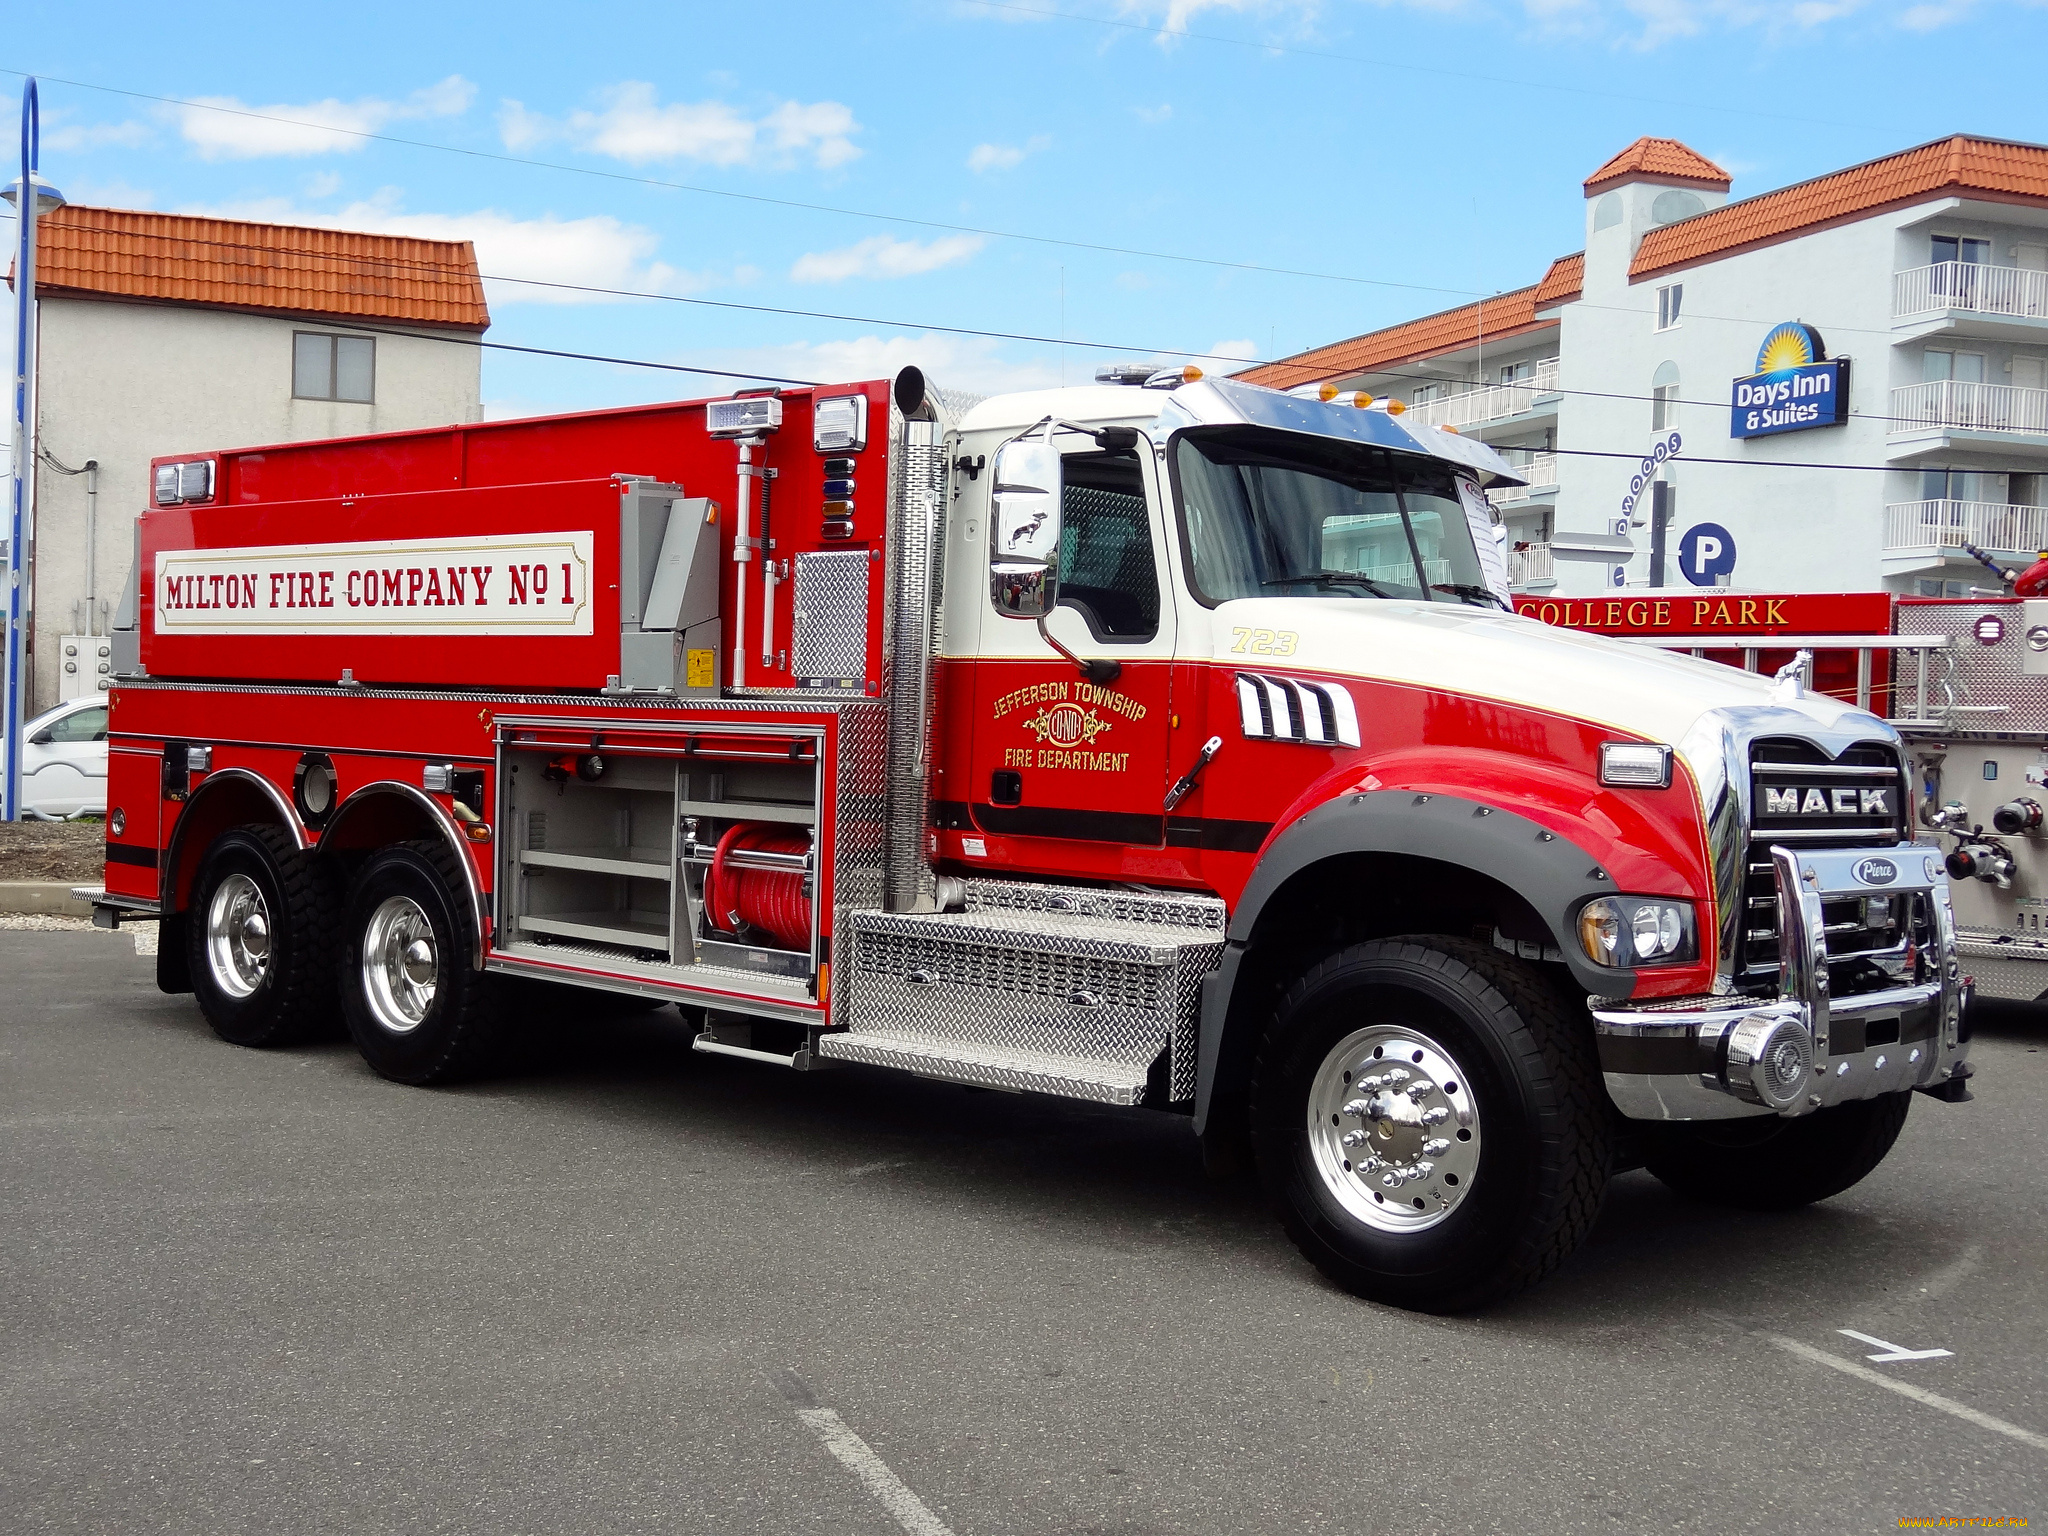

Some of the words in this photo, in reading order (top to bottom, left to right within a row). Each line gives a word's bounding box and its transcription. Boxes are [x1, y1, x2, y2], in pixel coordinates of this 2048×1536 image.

[1737, 380, 1790, 407] Days
[1793, 373, 1830, 398] Inn
[1746, 411, 1760, 430] &
[1761, 402, 1819, 428] Suites
[1695, 535, 1722, 574] P
[166, 573, 258, 610] MILTON
[269, 571, 335, 609] FIRE
[347, 566, 493, 608] COMPANY
[561, 563, 575, 605] 1
[1518, 601, 1672, 627] COLLEGE
[1692, 599, 1790, 626] PARK
[1230, 626, 1300, 657] 723
[993, 681, 1069, 720] JEFFERSON
[1073, 681, 1148, 722] TOWNSHIP
[1004, 748, 1033, 768] FIRE
[1037, 749, 1130, 773] DEPARTMENT
[1765, 787, 1890, 814] MACK
[1862, 860, 1894, 880] Pierce
